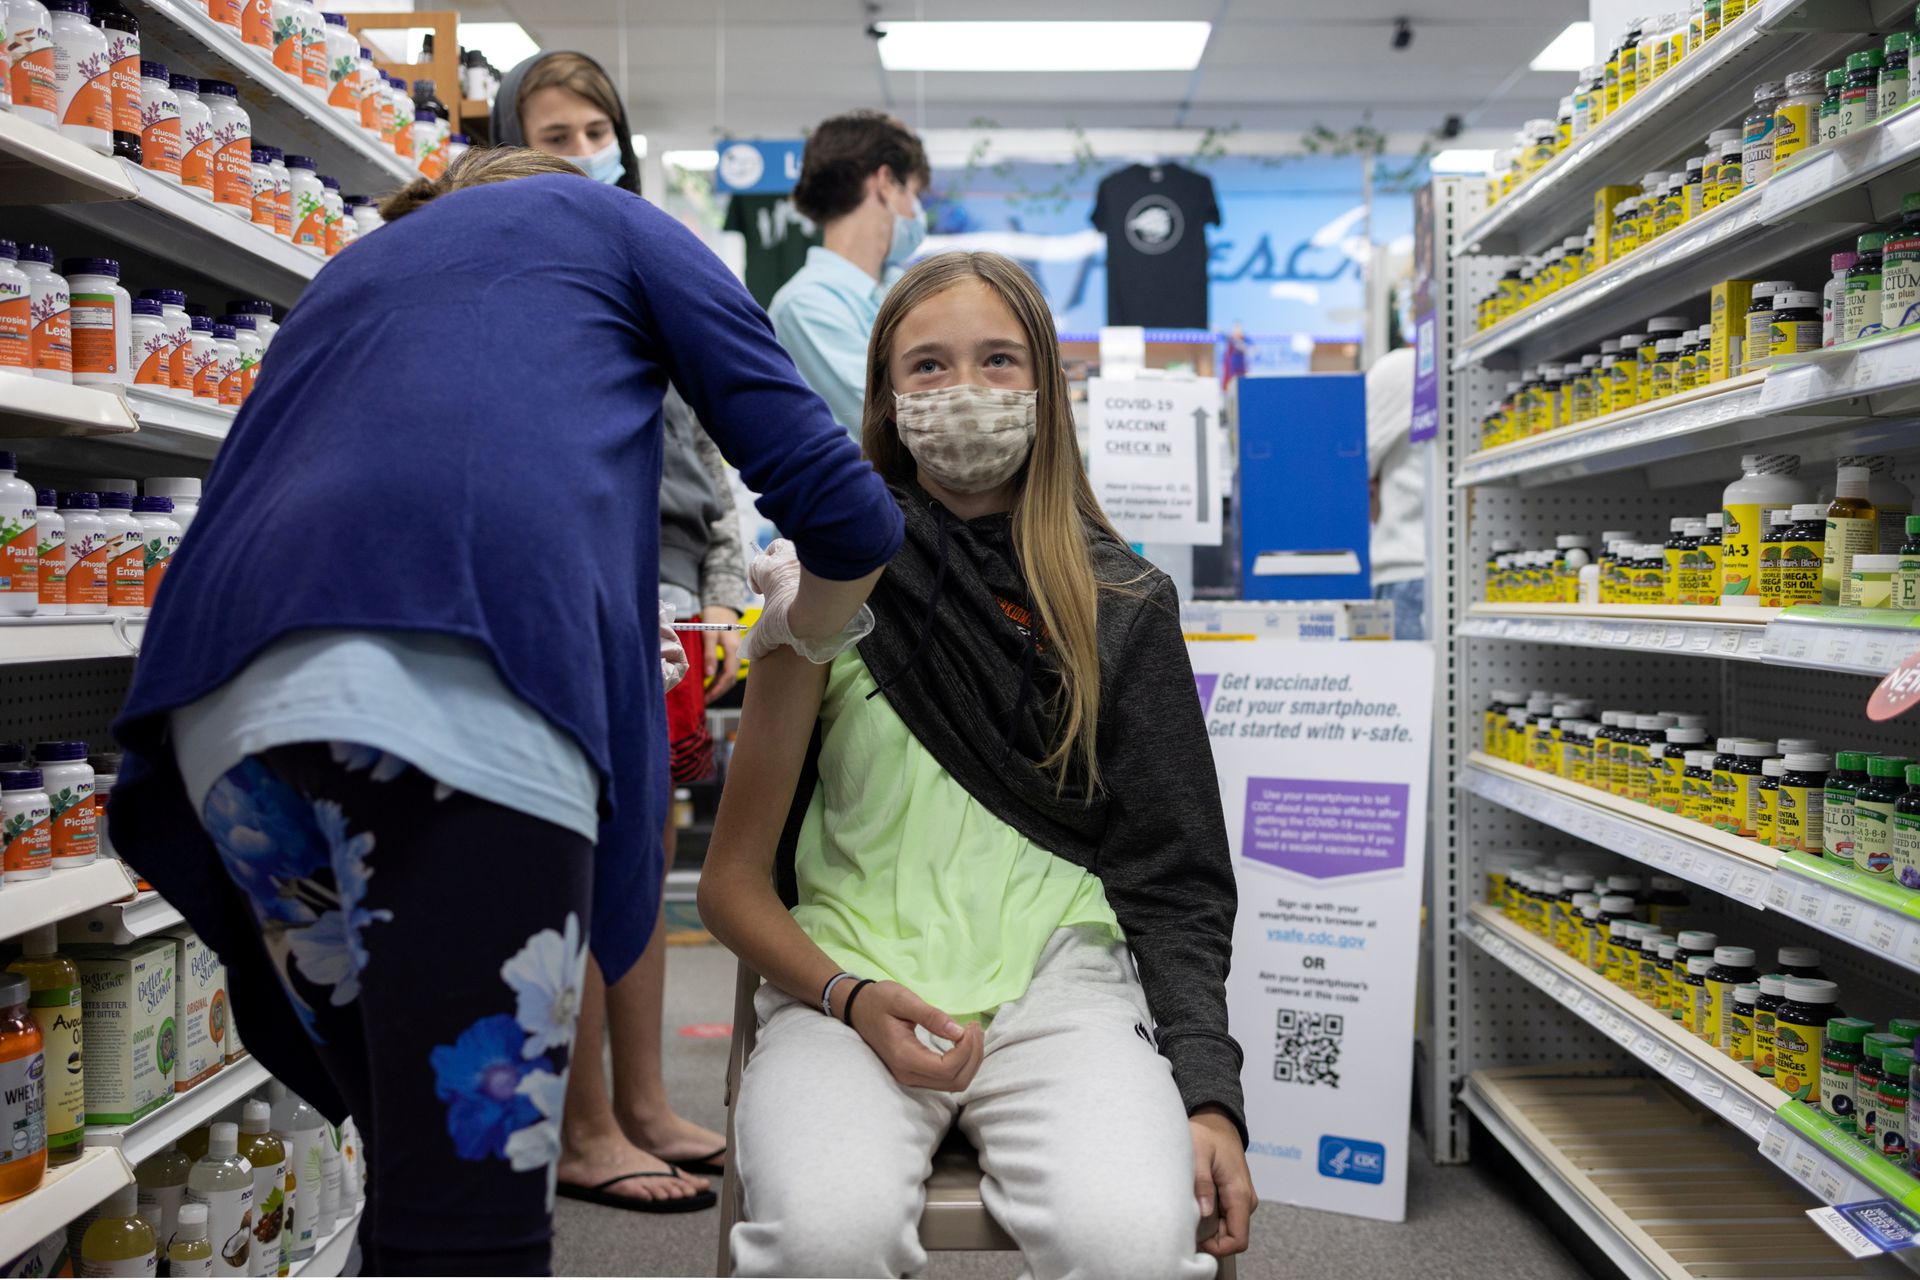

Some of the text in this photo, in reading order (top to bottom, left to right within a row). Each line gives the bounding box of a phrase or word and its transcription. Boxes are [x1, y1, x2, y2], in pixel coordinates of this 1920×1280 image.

[1898, 290, 1915, 299] plus
[1105, 420, 1167, 431] VACCINE
[1105, 440, 1171, 452] CHECK IN
[6, 546, 27, 556] Pau
[1799, 581, 1814, 589] OIL
[1903, 579, 1915, 600] E
[1222, 673, 1352, 692] Get vaccinated.
[1215, 697, 1402, 719] Get your smartphone.
[1209, 720, 1413, 742] Get started with v-safe.
[1283, 791, 1303, 802] your
[1305, 792, 1360, 804] smartphone
[79, 808, 94, 817] Zinc
[1275, 803, 1301, 813] about
[1303, 805, 1320, 816] any
[1322, 804, 1341, 815] side
[1344, 805, 1376, 817] effects
[1378, 807, 1401, 818] after
[1289, 816, 1303, 826] the
[1301, 830, 1317, 841] get
[1319, 831, 1365, 842] reminders
[1376, 834, 1395, 845] you
[1864, 829, 1887, 838] 3-6-9
[1277, 898, 1297, 910] Sign
[1315, 902, 1334, 911] with
[1338, 905, 1359, 914] your
[1324, 916, 1364, 926] browser
[1266, 927, 1366, 950] vsafe.cdc.gov
[1302, 956, 1325, 970] OR
[138, 967, 163, 1002] Better
[1280, 974, 1299, 983] your
[1265, 986, 1300, 996] camera
[1315, 990, 1332, 1000] this
[1335, 993, 1359, 1003] code
[133, 1025, 154, 1045] ORGANIC
[1757, 1034, 1774, 1044] ZINC
[1778, 1052, 1793, 1063] ZINC
[5, 1083, 34, 1106] WHEY
[1354, 1154, 1379, 1169] CDC
